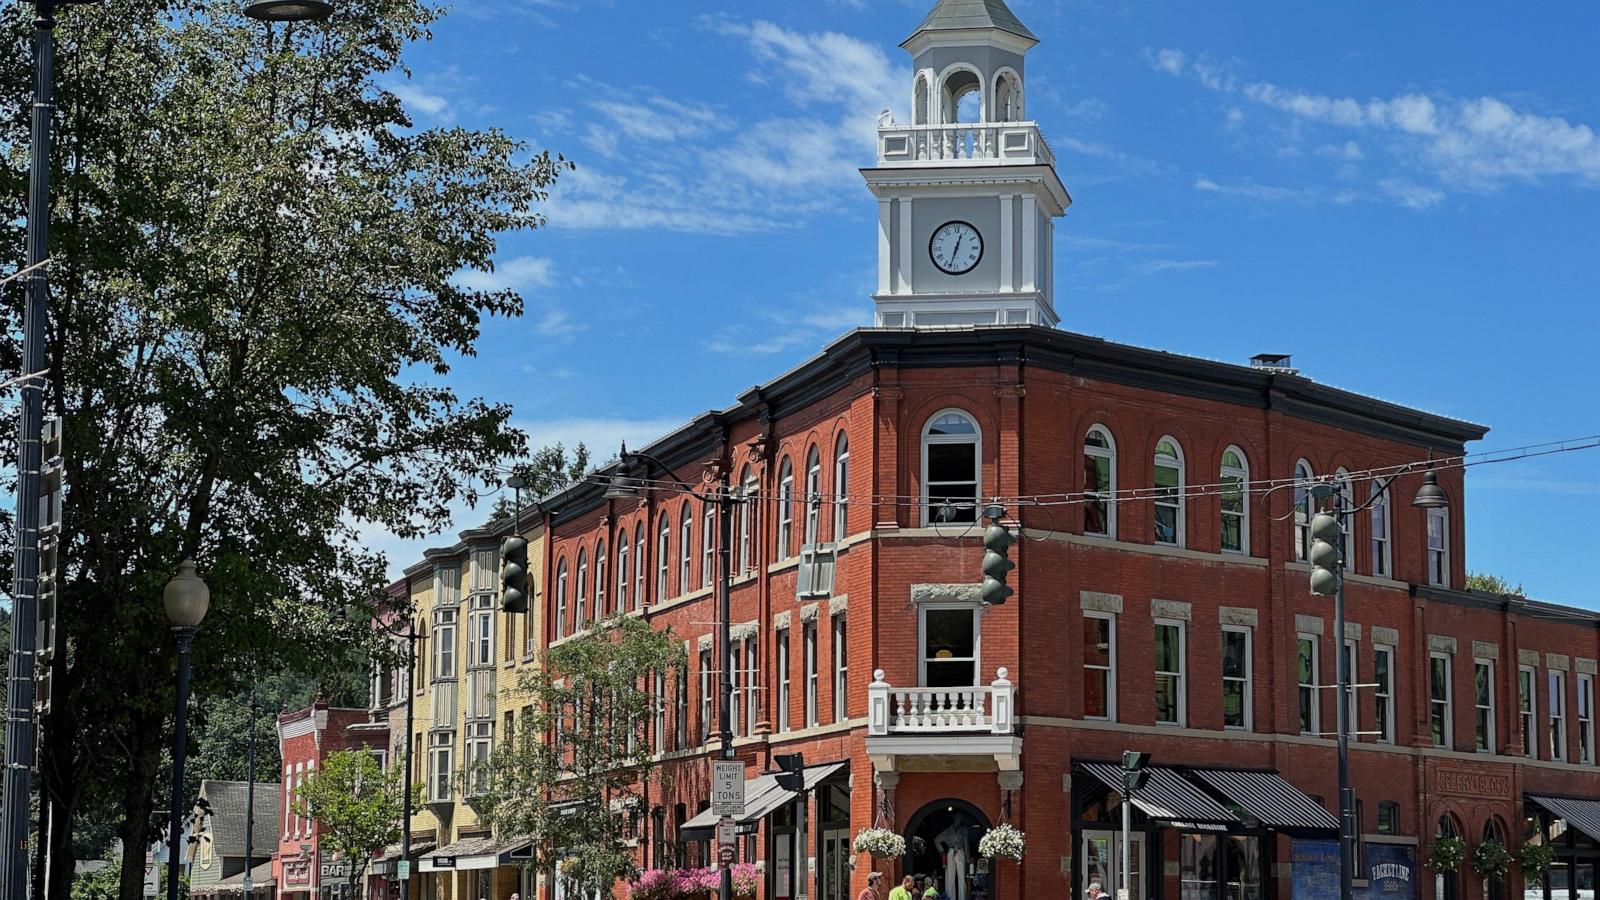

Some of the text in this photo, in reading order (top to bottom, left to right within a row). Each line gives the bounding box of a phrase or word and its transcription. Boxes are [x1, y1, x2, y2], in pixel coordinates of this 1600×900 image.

[716, 764, 742, 772] WEIGHT
[719, 772, 738, 780] LIMIT
[725, 781, 732, 790] 5
[1439, 773, 1510, 795] SPERRY BLOCK
[717, 791, 741, 800] TONS
[321, 865, 345, 876] BAR
[1372, 863, 1409, 881] PACKET LINE
